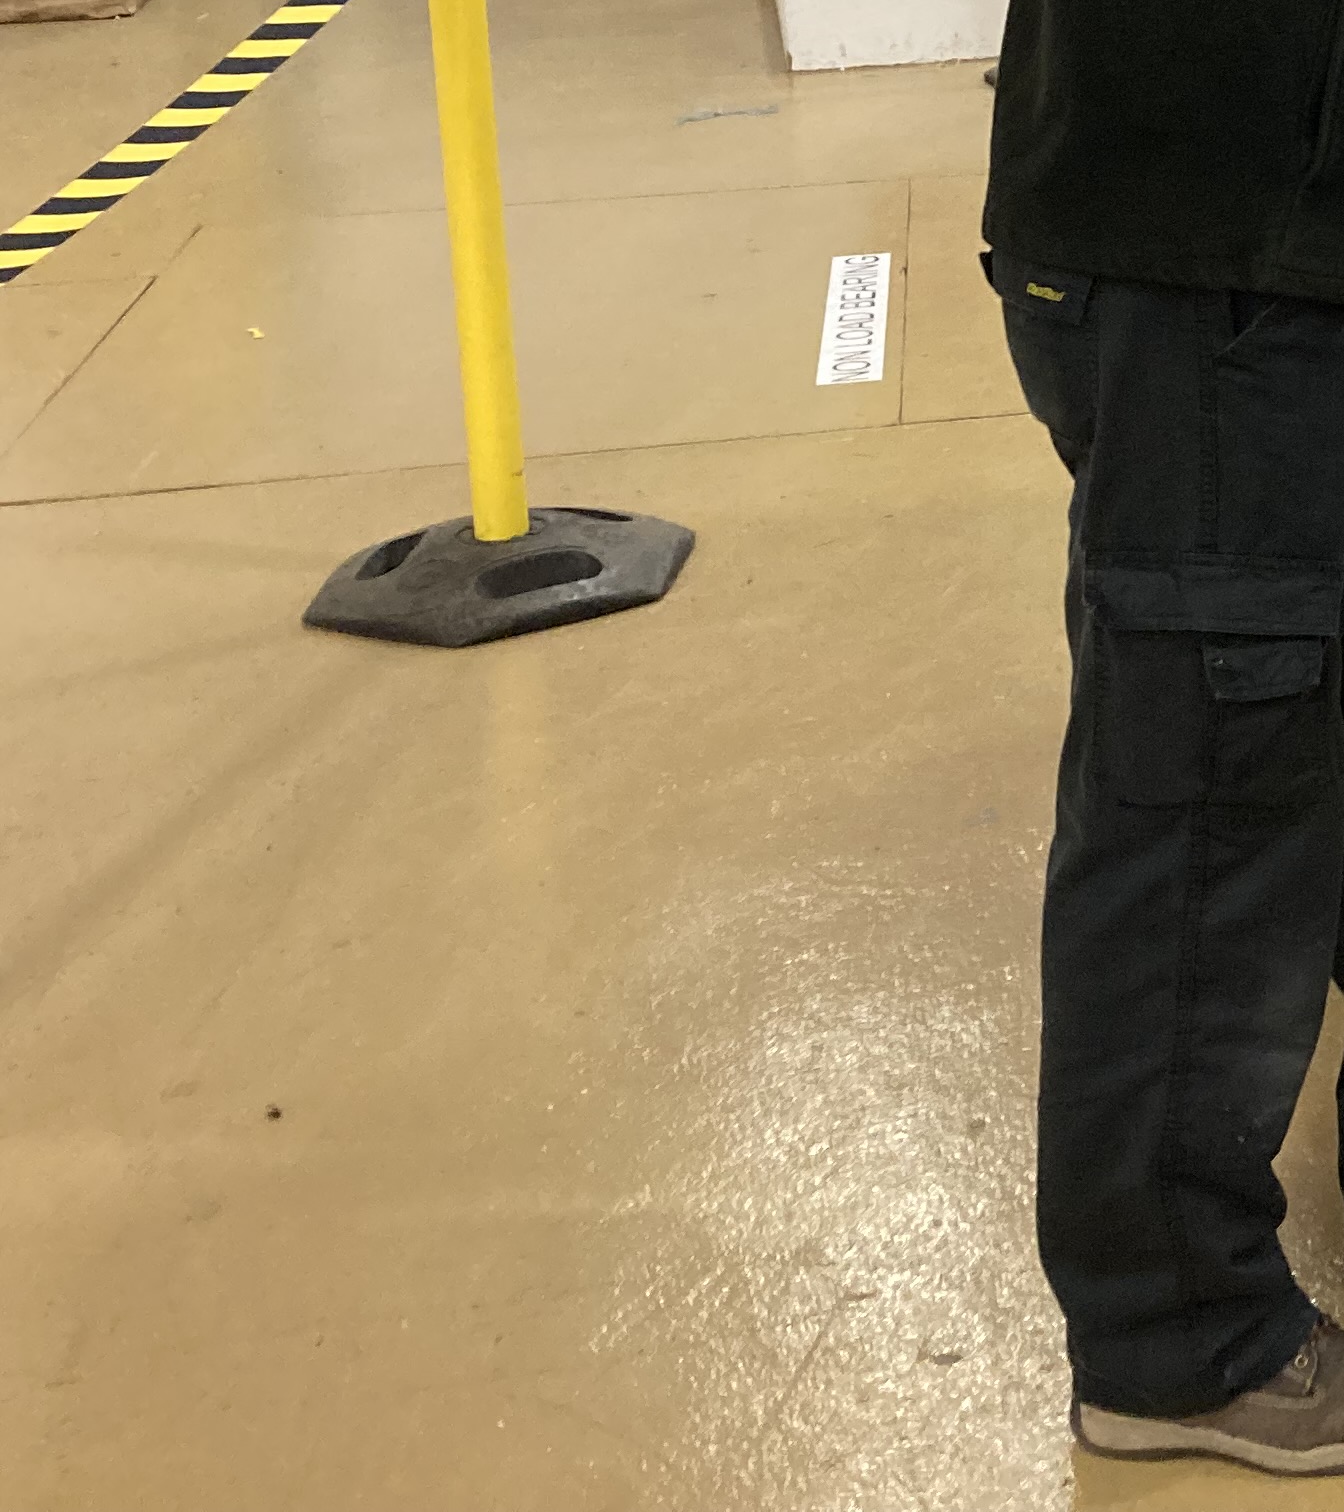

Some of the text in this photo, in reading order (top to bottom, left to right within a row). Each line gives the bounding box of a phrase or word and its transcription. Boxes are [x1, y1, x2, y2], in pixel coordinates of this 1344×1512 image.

[831, 255, 880, 383] NON LOAD BEARING
